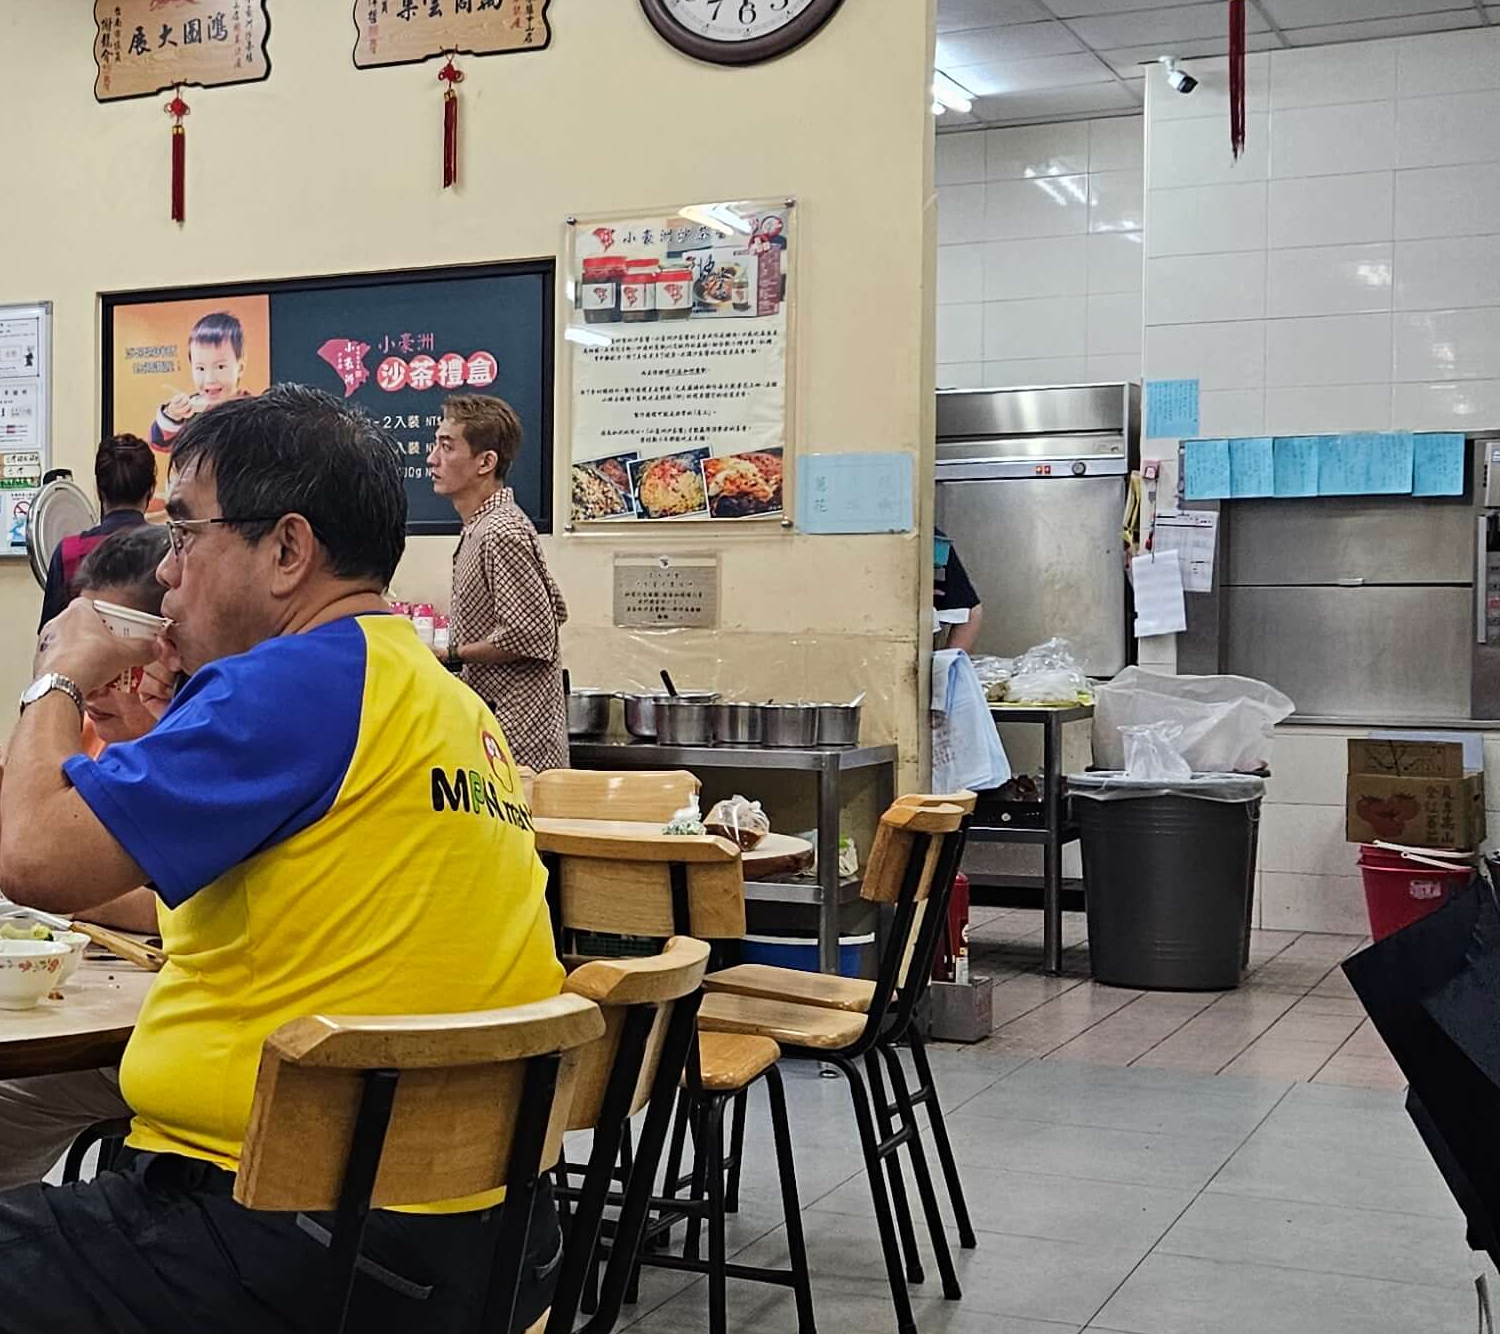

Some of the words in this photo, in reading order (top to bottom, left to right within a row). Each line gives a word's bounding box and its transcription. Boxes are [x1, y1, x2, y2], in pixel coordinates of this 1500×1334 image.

[738, 1, 756, 25] 6
[128, 12, 229, 56] 鴻圖大展
[378, 332, 436, 354] 小豪洲
[380, 356, 493, 389] 沙茶禮盒
